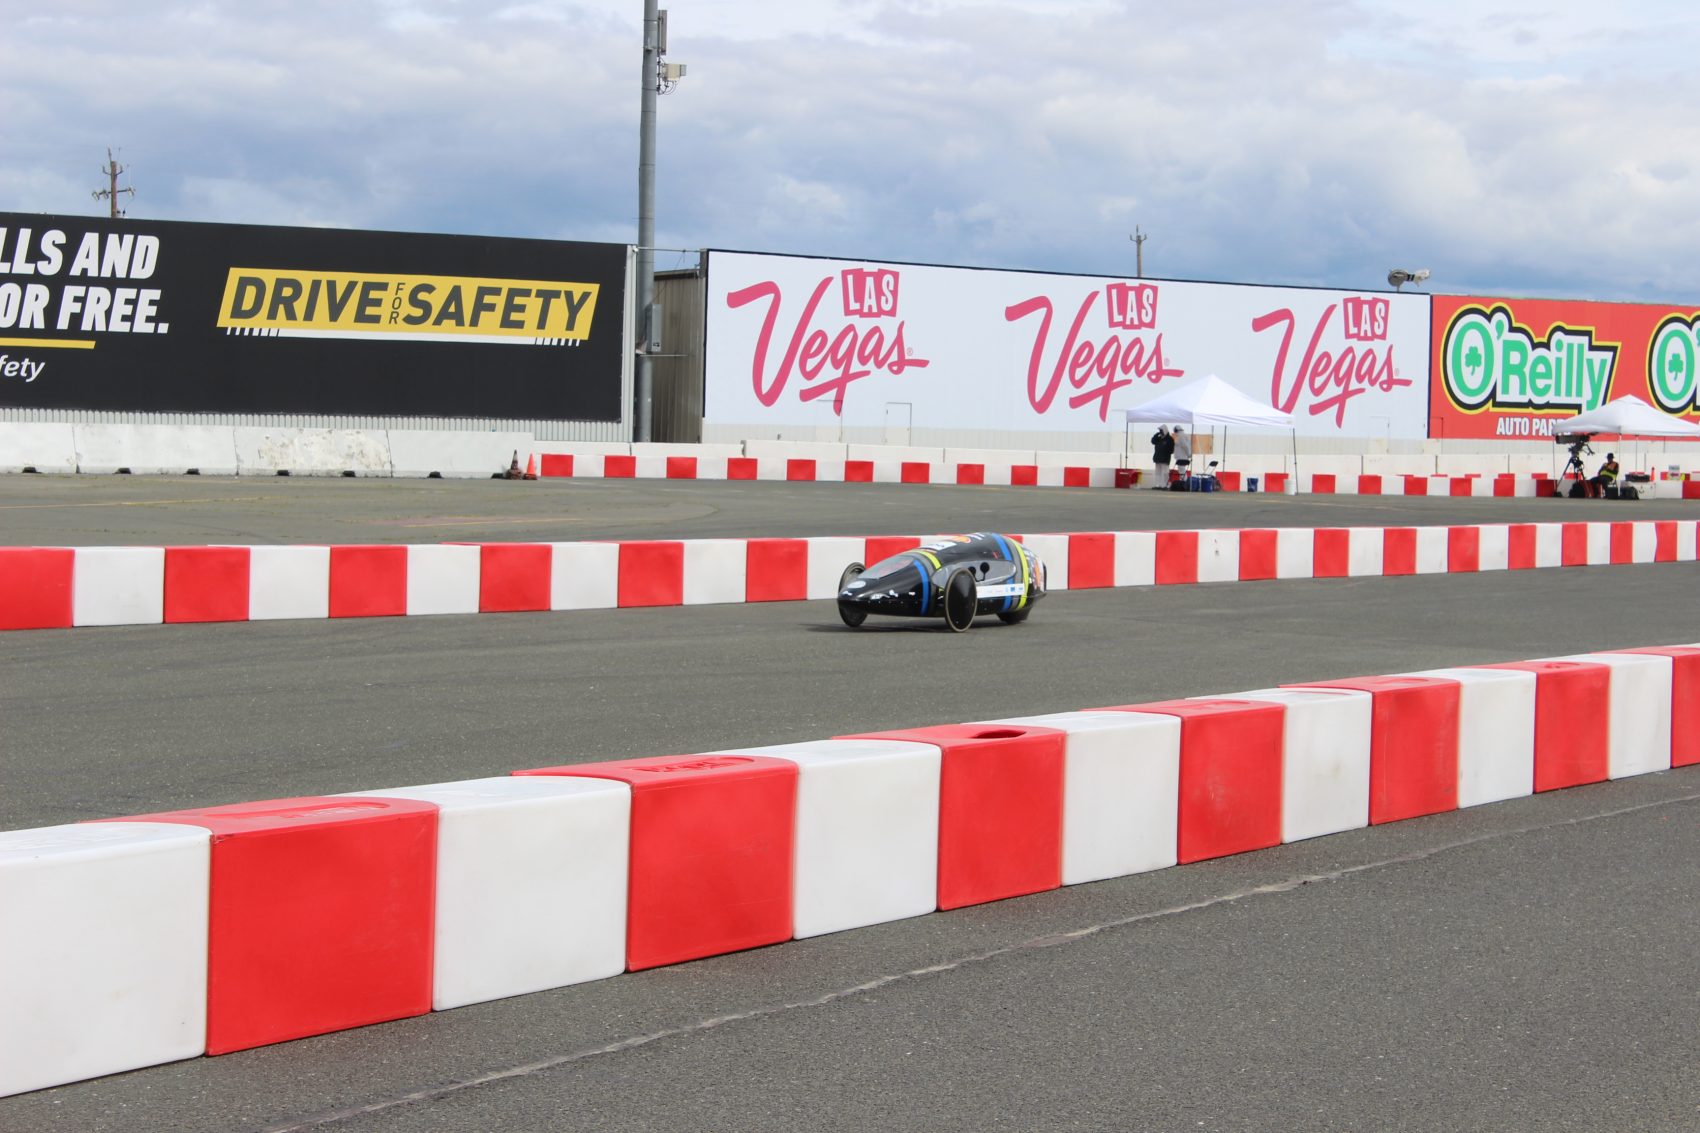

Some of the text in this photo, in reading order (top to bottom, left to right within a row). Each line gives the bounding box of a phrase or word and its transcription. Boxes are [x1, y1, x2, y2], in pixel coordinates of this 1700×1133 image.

[69, 232, 160, 279] AND
[56, 285, 169, 334] FREE.
[229, 276, 592, 332] DRIVE FOR SAFETY
[847, 274, 895, 313] LAS
[1111, 288, 1153, 325] LAS
[1347, 302, 1385, 336] LAS
[727, 276, 930, 416] Vegas
[1005, 290, 1184, 422] Vegas
[1252, 304, 1413, 428] Vegas
[1452, 319, 1607, 411] O'Reilly
[1496, 417, 1530, 436] AUTO
